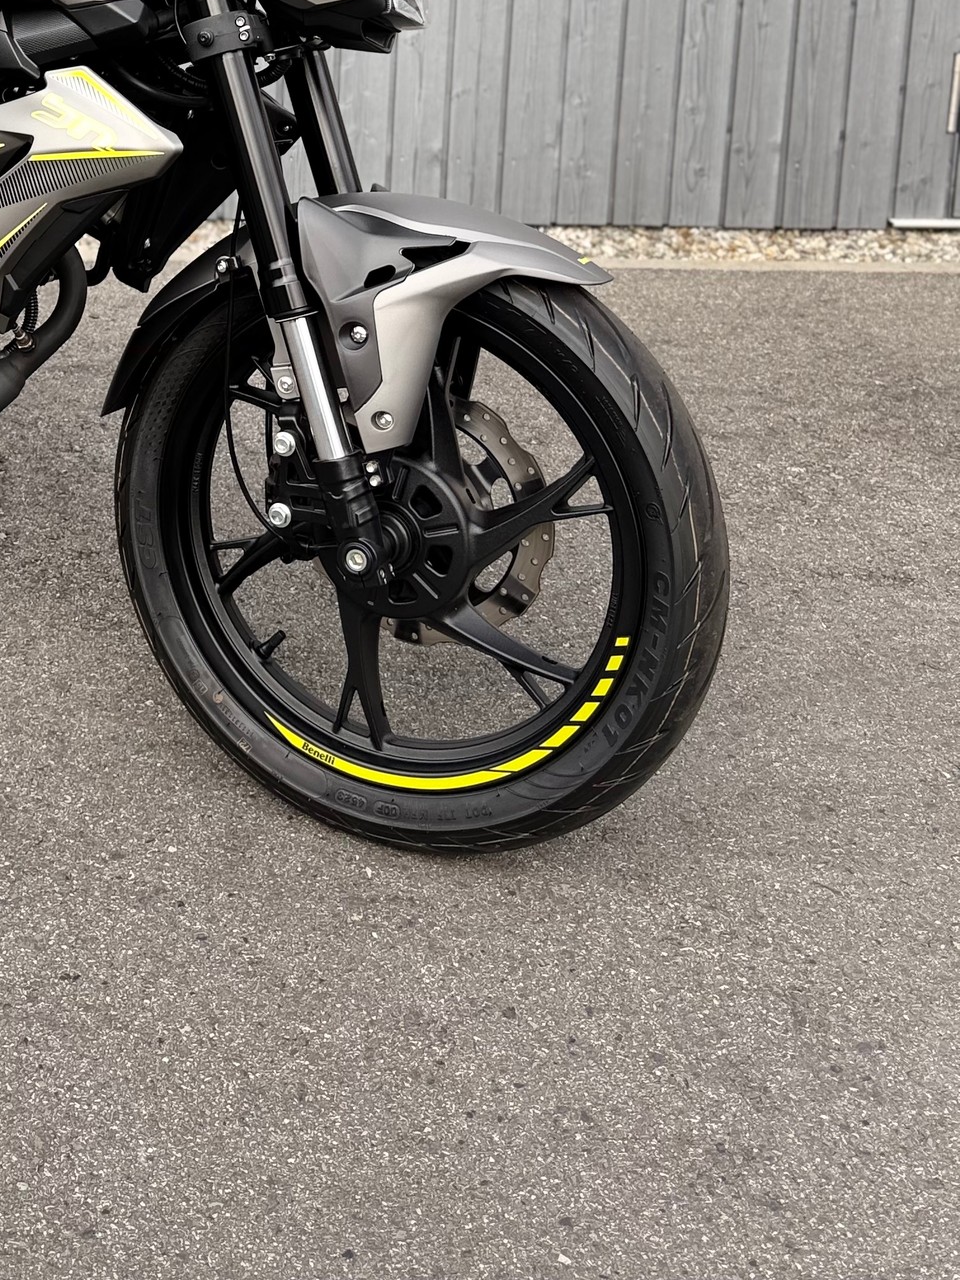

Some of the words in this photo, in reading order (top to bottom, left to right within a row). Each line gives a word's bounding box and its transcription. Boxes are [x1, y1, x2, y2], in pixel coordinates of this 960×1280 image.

[132, 497, 157, 569] CST
[602, 570, 672, 750] CM-NK01
[300, 740, 337, 766] Benelli
